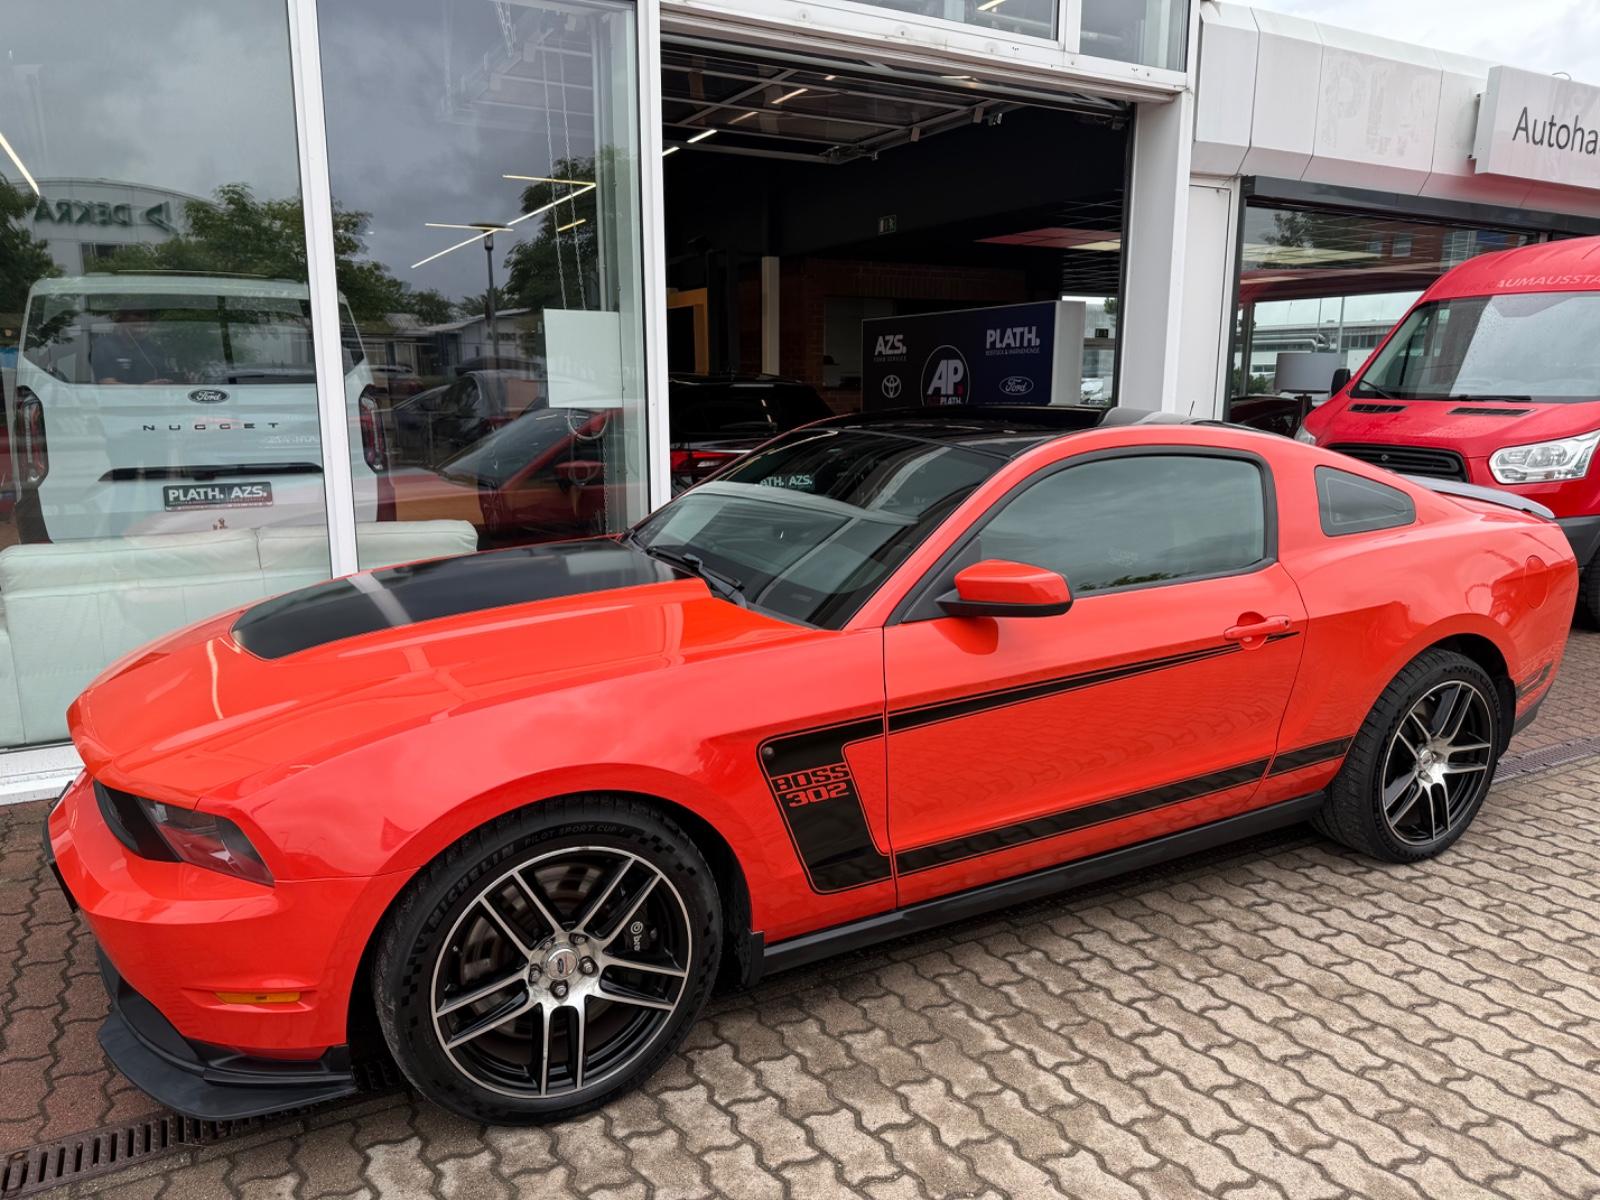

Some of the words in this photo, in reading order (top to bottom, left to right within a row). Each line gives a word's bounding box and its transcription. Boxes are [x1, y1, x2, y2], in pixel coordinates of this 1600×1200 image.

[1512, 106, 1600, 155] Autoha
[875, 334, 907, 355] AZS.
[986, 326, 1041, 349] PLATH.
[1004, 377, 1027, 393] Ford
[197, 390, 223, 401] Ford
[143, 422, 279, 431] NUGGET
[789, 474, 812, 486] AZS.
[168, 487, 224, 502] PLATH.
[231, 485, 268, 498] AZS.
[771, 764, 850, 792] BOSS
[785, 782, 850, 807] 302
[427, 842, 515, 930] MICHELIN
[632, 935, 643, 952] bre
